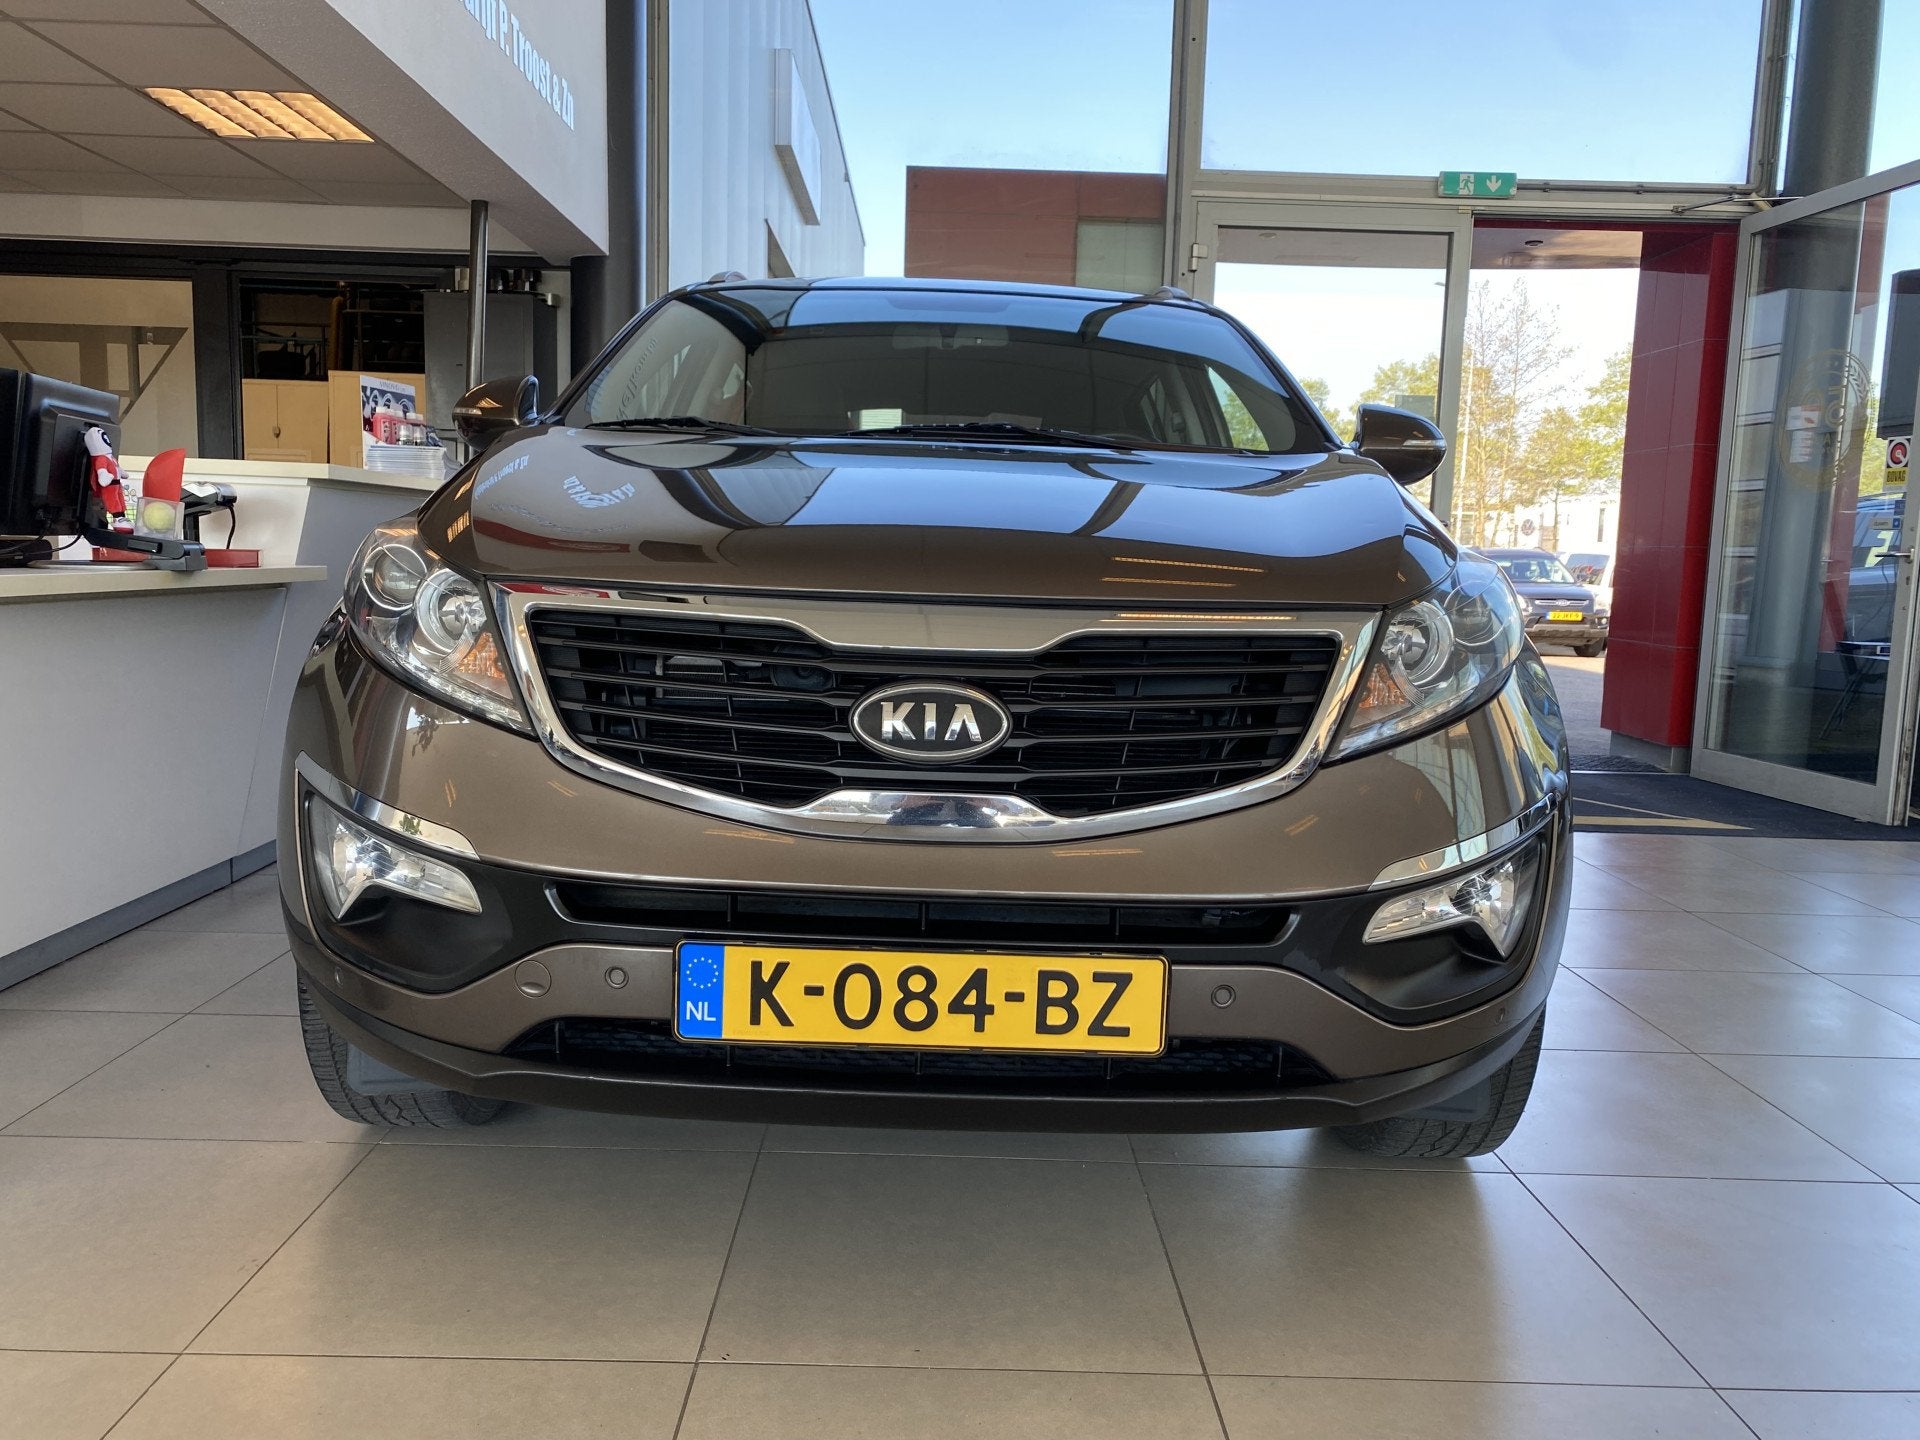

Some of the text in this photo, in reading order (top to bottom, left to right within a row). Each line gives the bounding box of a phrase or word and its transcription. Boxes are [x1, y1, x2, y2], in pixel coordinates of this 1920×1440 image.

[511, 13, 551, 104] Troost
[552, 74, 561, 116] &
[561, 78, 574, 131] Zn
[1887, 471, 1906, 483] BOVAG
[880, 701, 982, 742] KIA
[686, 1001, 716, 1022] NL
[749, 960, 1133, 1038] K-084-BZ
